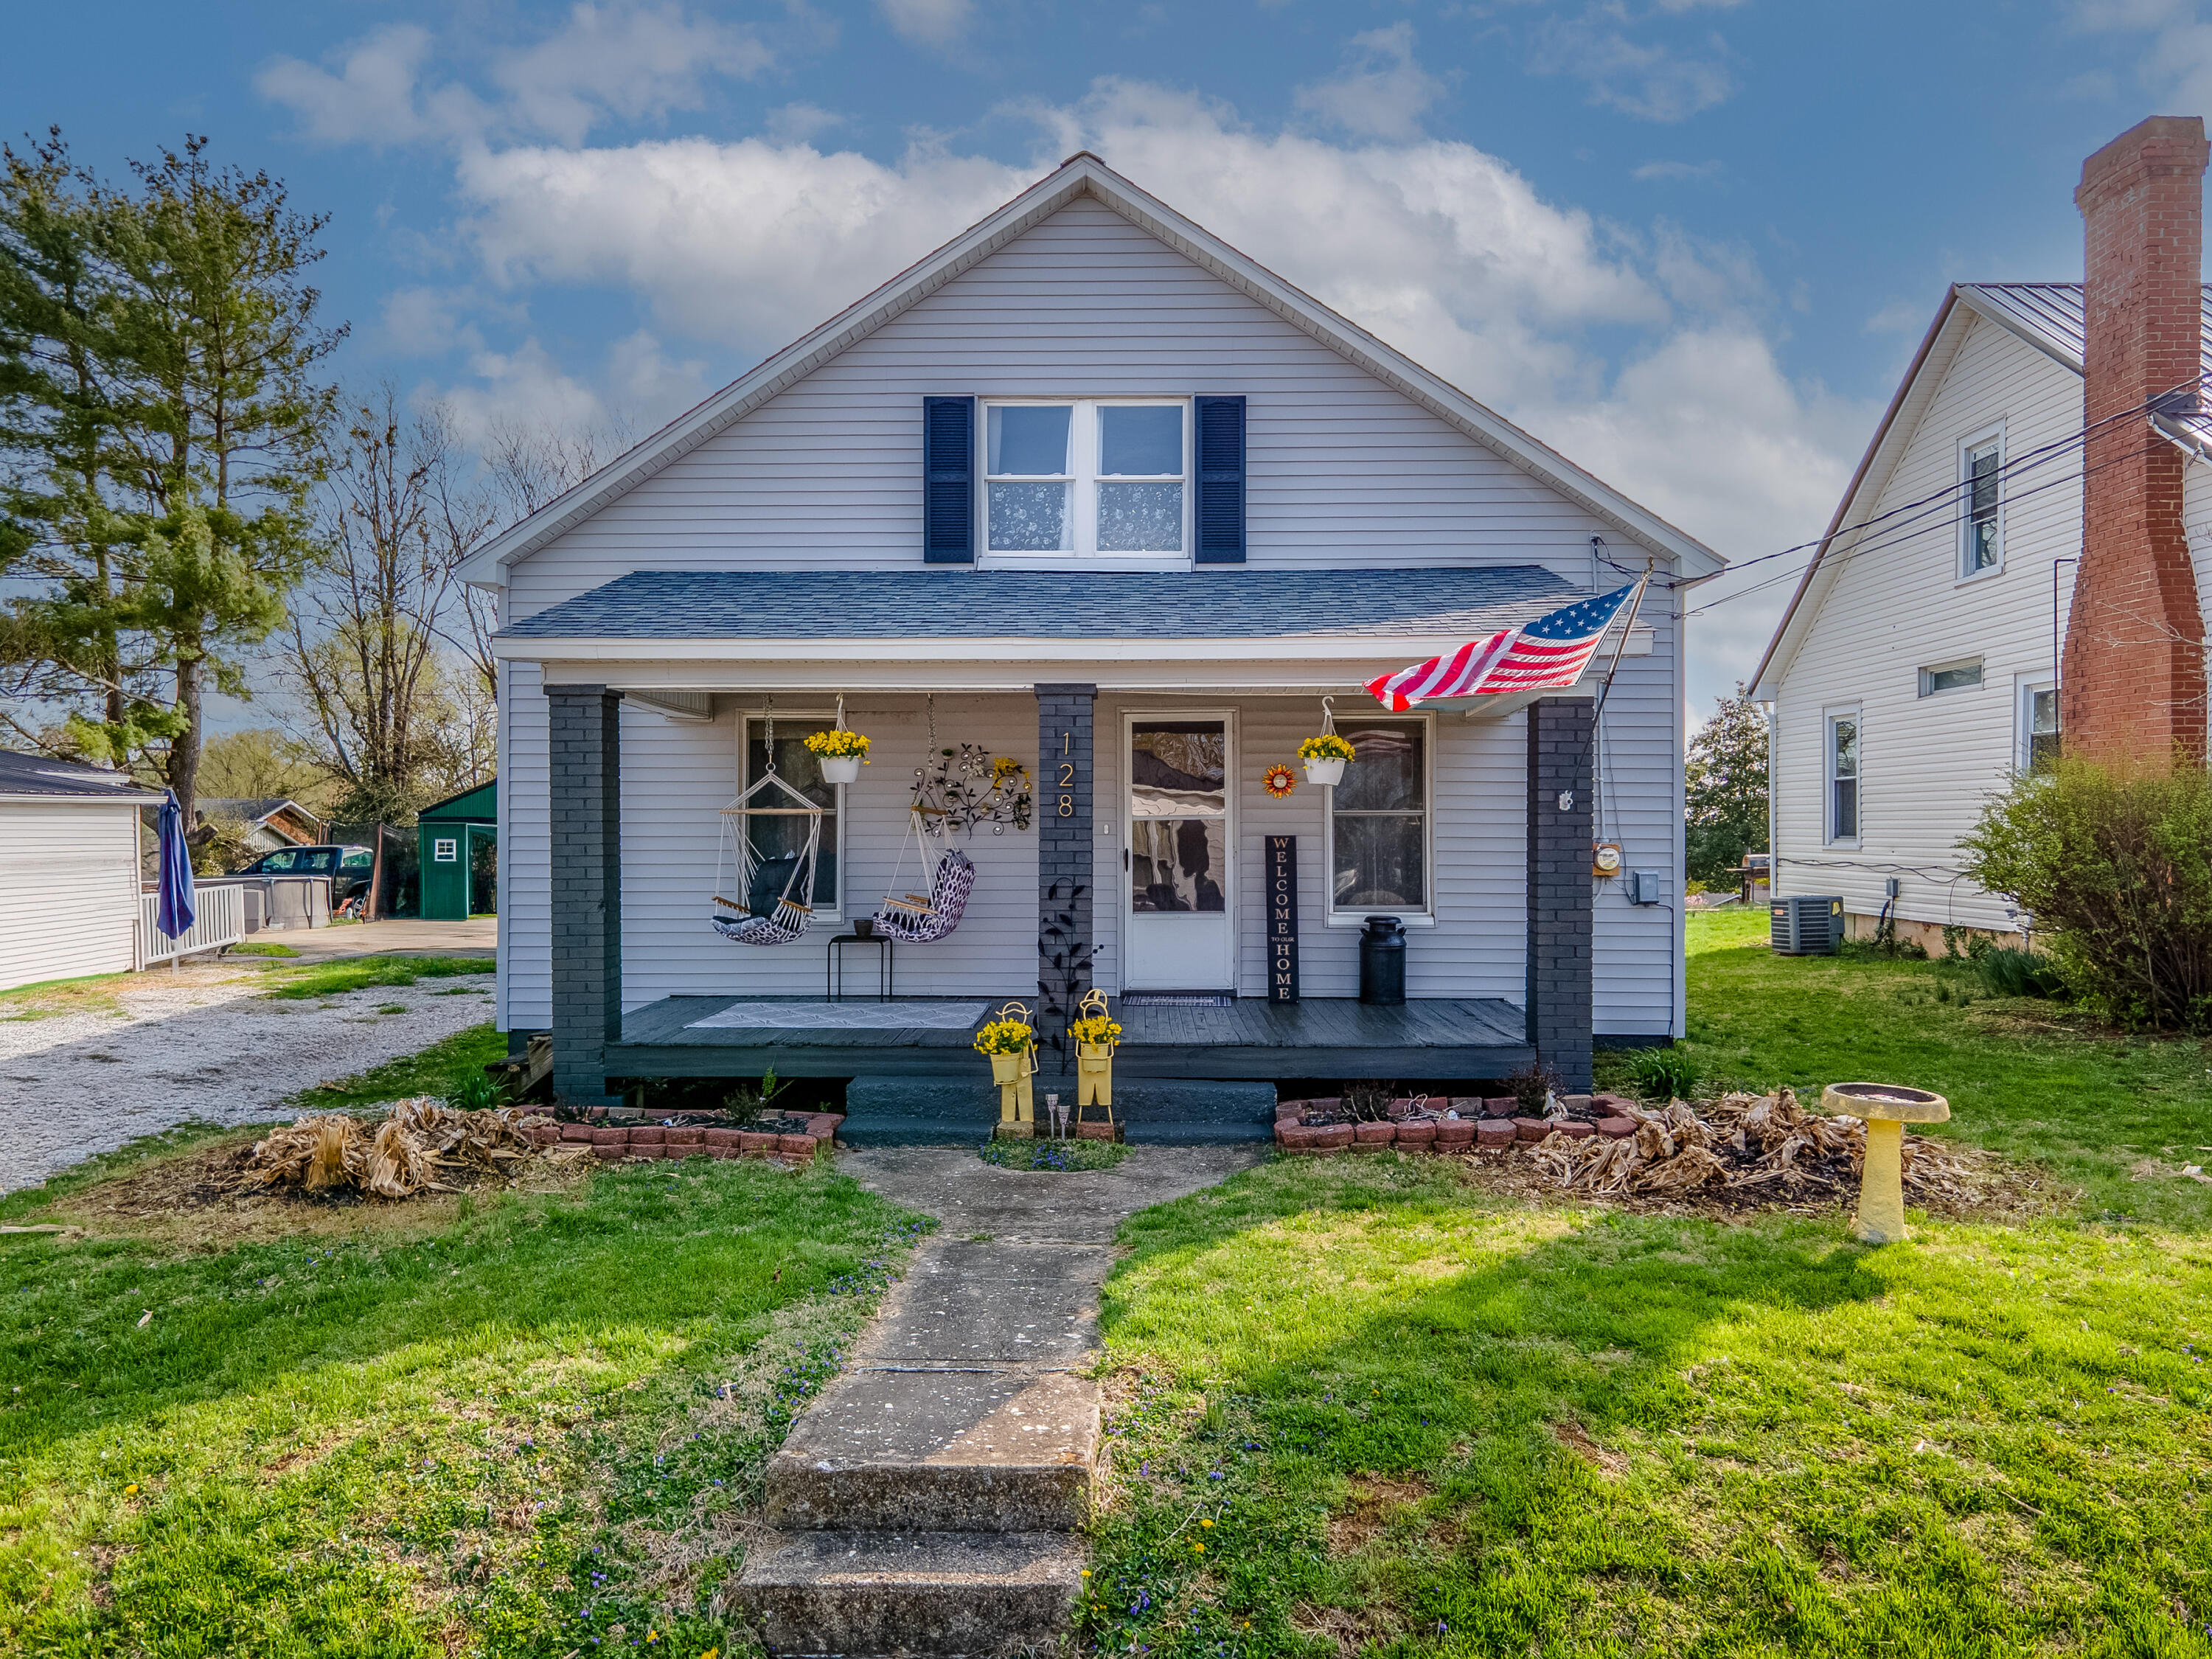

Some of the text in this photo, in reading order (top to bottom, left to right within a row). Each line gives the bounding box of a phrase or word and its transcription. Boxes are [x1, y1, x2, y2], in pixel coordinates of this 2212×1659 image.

[1059, 732, 1073, 817] 128
[1273, 838, 1290, 933] WELCOME
[1276, 944, 1292, 999] HOME
